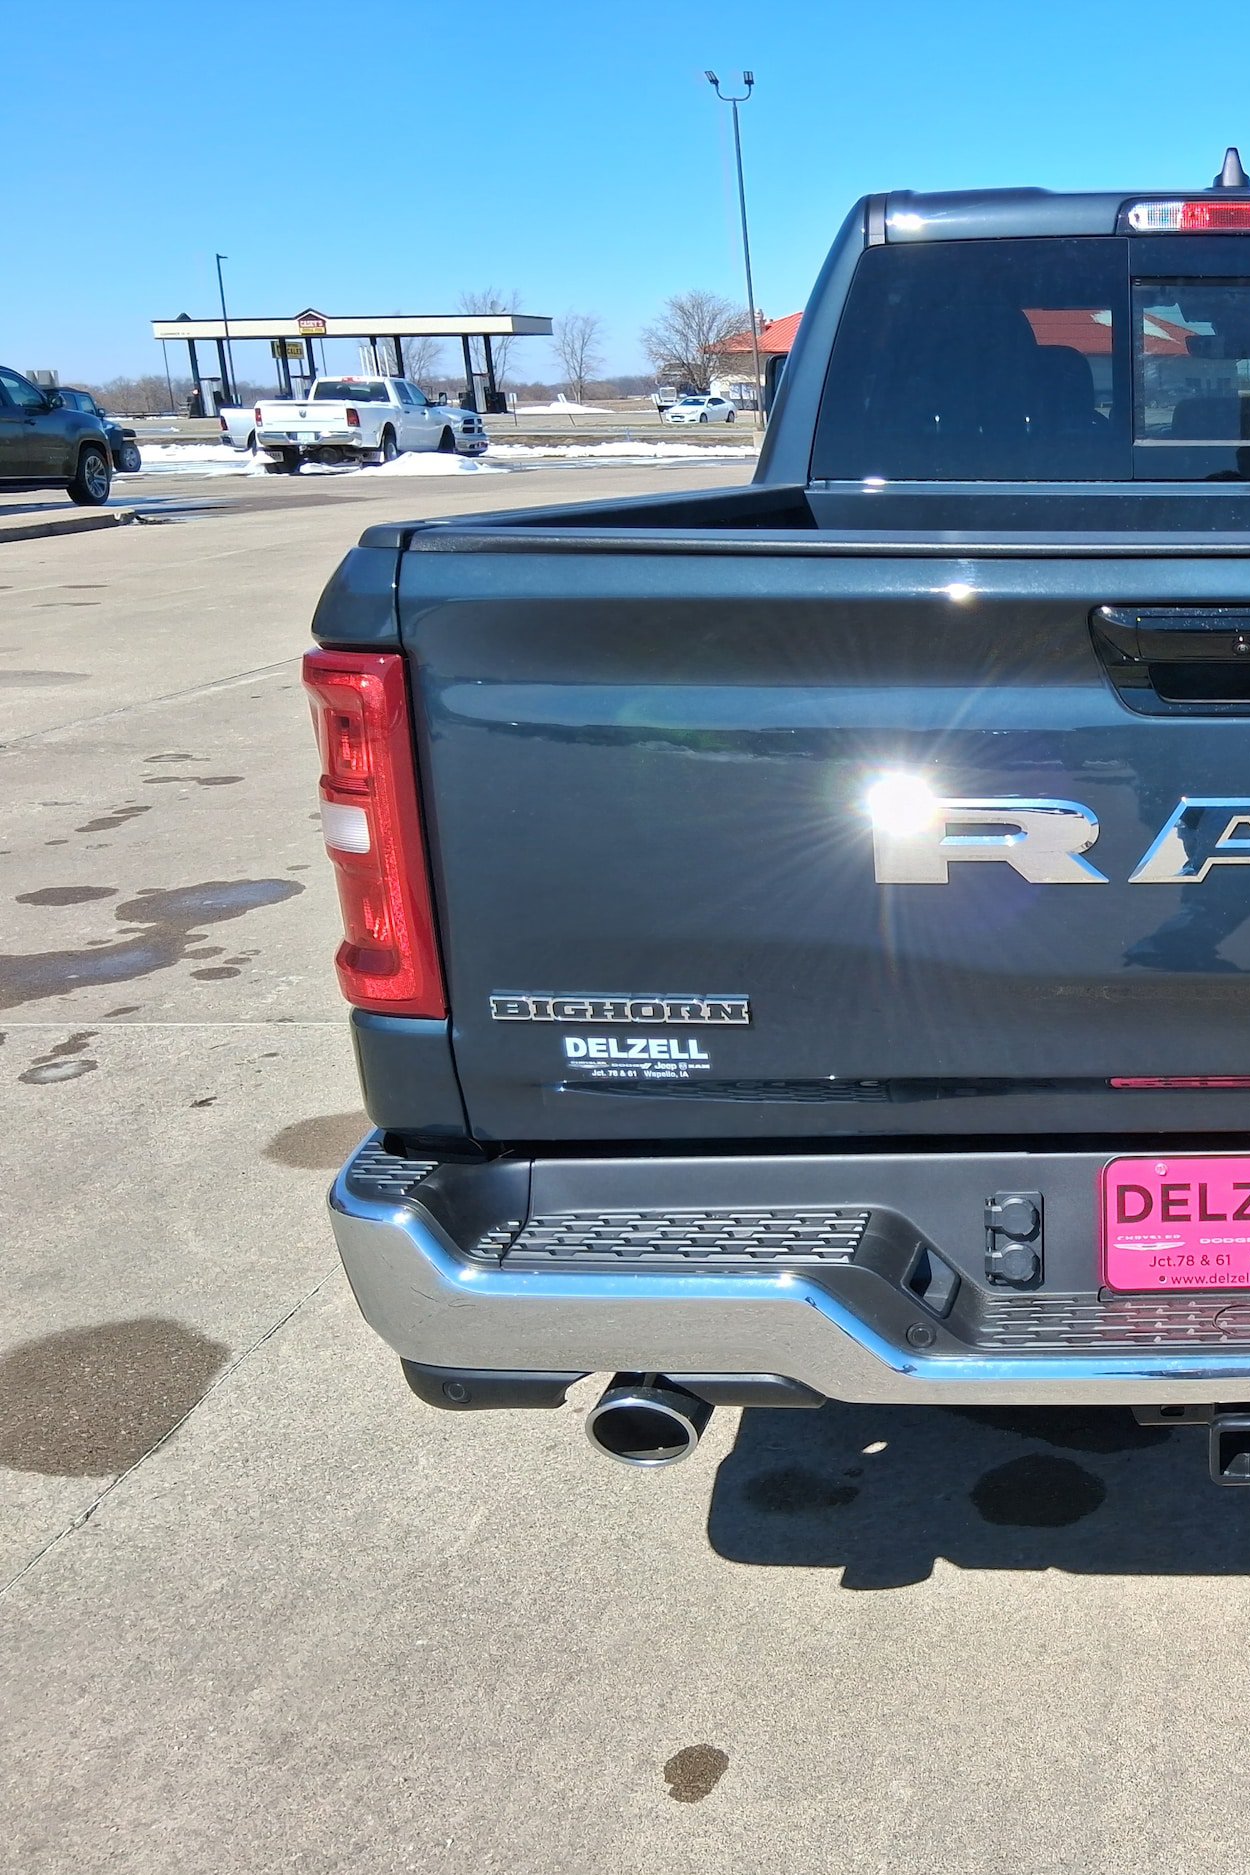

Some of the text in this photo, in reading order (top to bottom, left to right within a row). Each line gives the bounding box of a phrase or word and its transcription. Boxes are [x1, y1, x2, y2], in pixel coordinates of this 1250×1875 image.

[489, 990, 750, 1024] BIGHORN
[565, 1037, 709, 1059] DELZELL
[654, 1062, 677, 1071] Jeep
[680, 1070, 689, 1078] IA
[1200, 1254, 1210, 1266] &
[1216, 1254, 1231, 1266] 61
